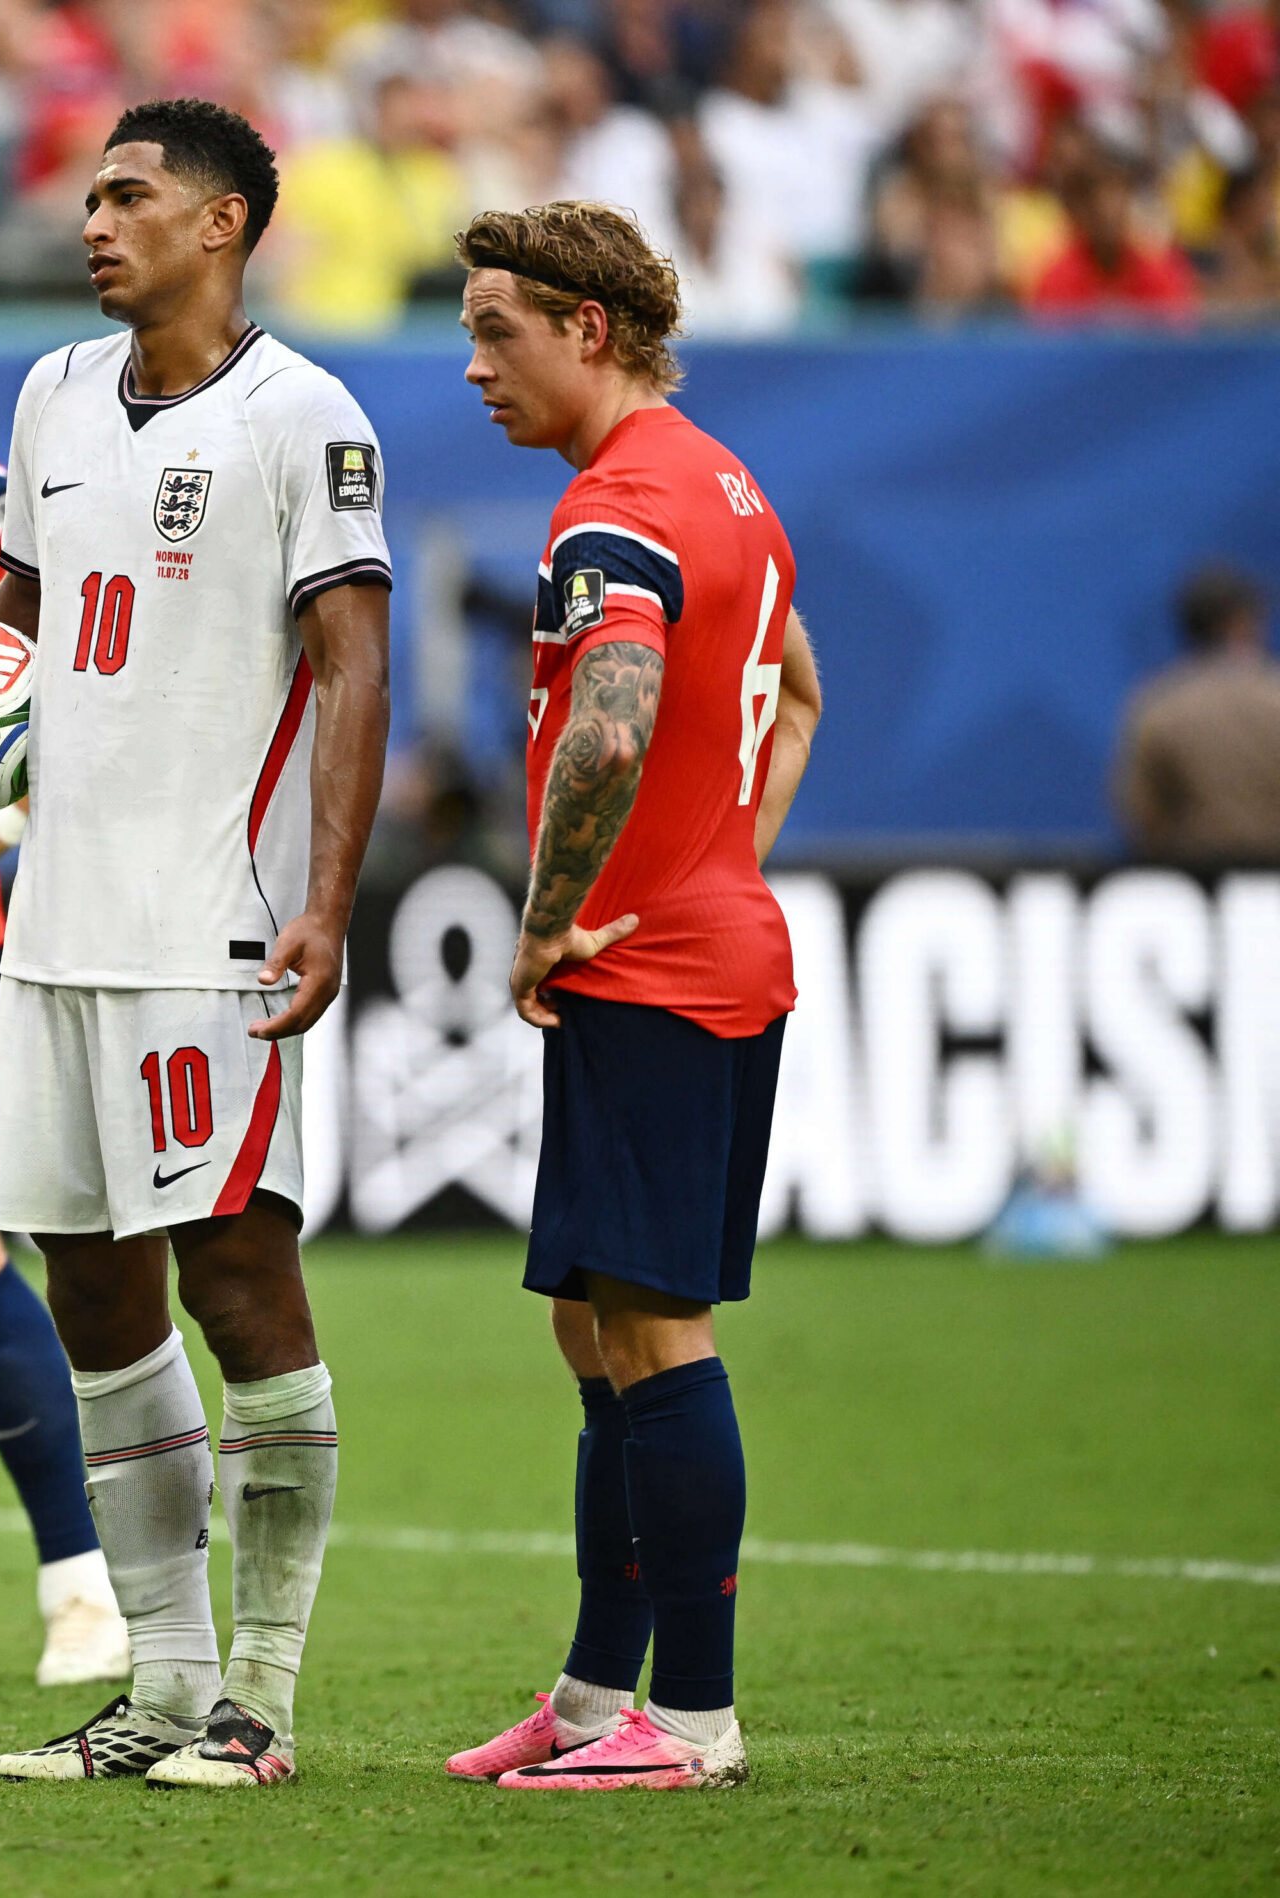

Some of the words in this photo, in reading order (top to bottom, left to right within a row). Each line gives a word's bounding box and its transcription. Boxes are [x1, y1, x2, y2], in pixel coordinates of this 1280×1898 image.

[352, 495, 368, 503] FIFA
[715, 470, 764, 516] BERG
[155, 549, 194, 565] NORWAY
[157, 566, 189, 580] 11.07.26
[73, 571, 136, 676] 10
[737, 554, 782, 806] 6
[756, 866, 1280, 1243] ACIS
[140, 1045, 214, 1153] 10
